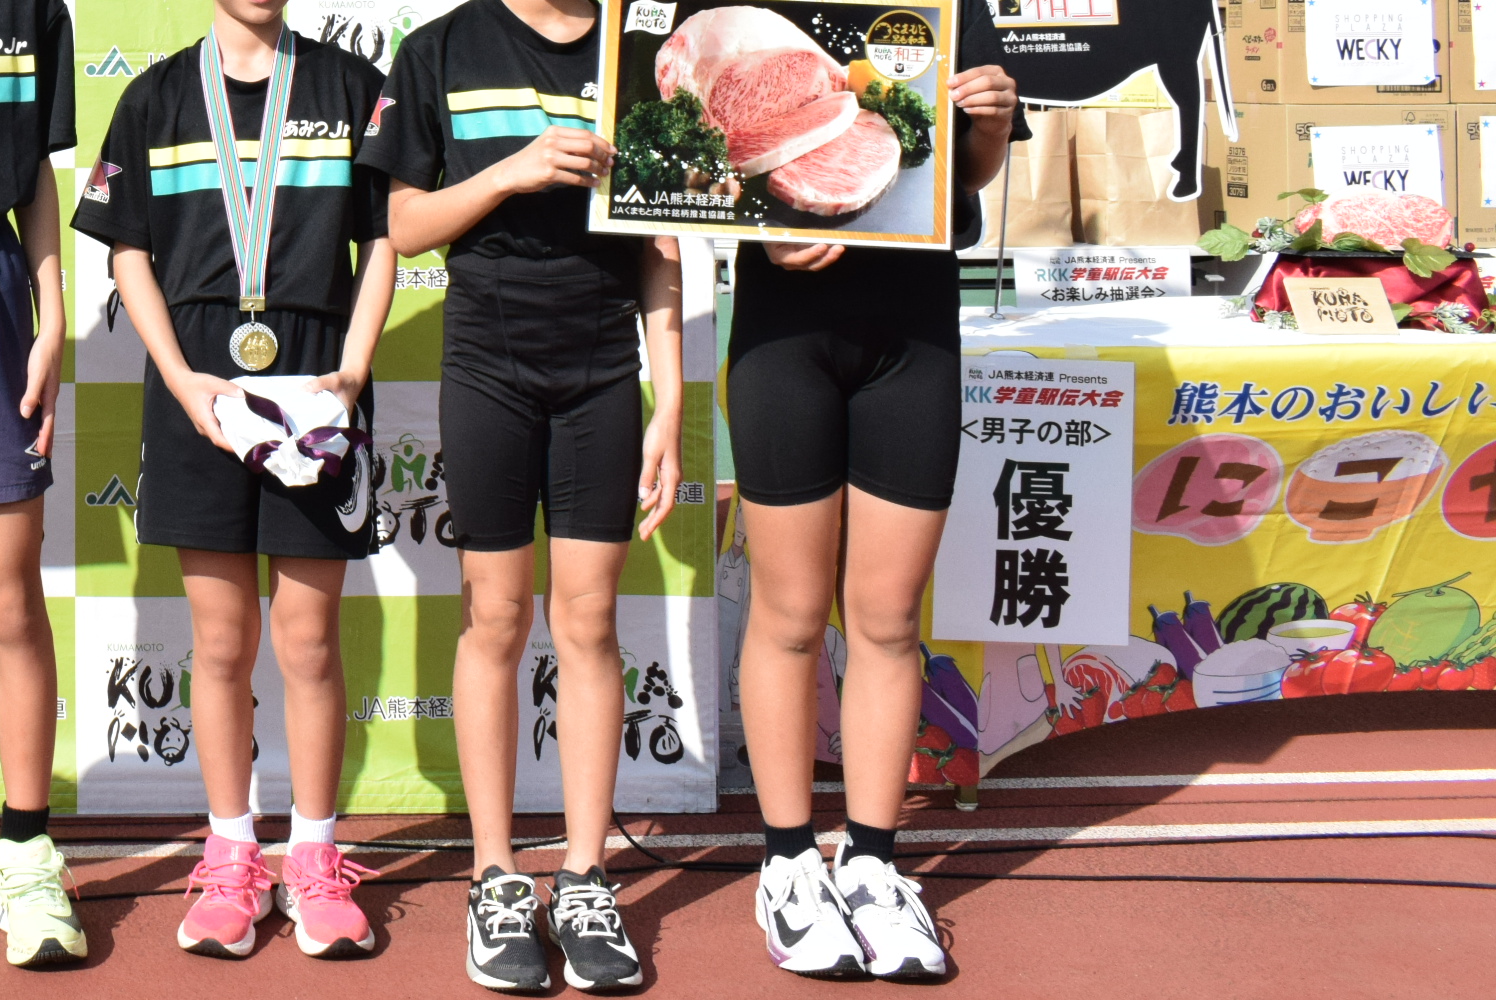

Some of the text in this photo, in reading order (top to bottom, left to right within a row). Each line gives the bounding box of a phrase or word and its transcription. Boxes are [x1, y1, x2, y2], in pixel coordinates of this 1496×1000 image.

[636, 5, 667, 19] KUMA
[635, 18, 667, 30] MOTO
[1004, 43, 1090, 53] もと肉牛銘柄推進協議会
[1336, 38, 1402, 60] WECKY
[650, 190, 735, 208] JA熊本経済連
[612, 207, 736, 220] JAくまもと肉牛銘柄推進協議会
[1065, 256, 1115, 264] JA熊本経済連
[1119, 256, 1156, 264] Presents
[988, 370, 1108, 385] JA熊本経済連 Presents
[963, 386, 1124, 408] KK学童駅伝大会
[990, 458, 1073, 629] 優勝
[355, 696, 456, 720] JA熊本経
